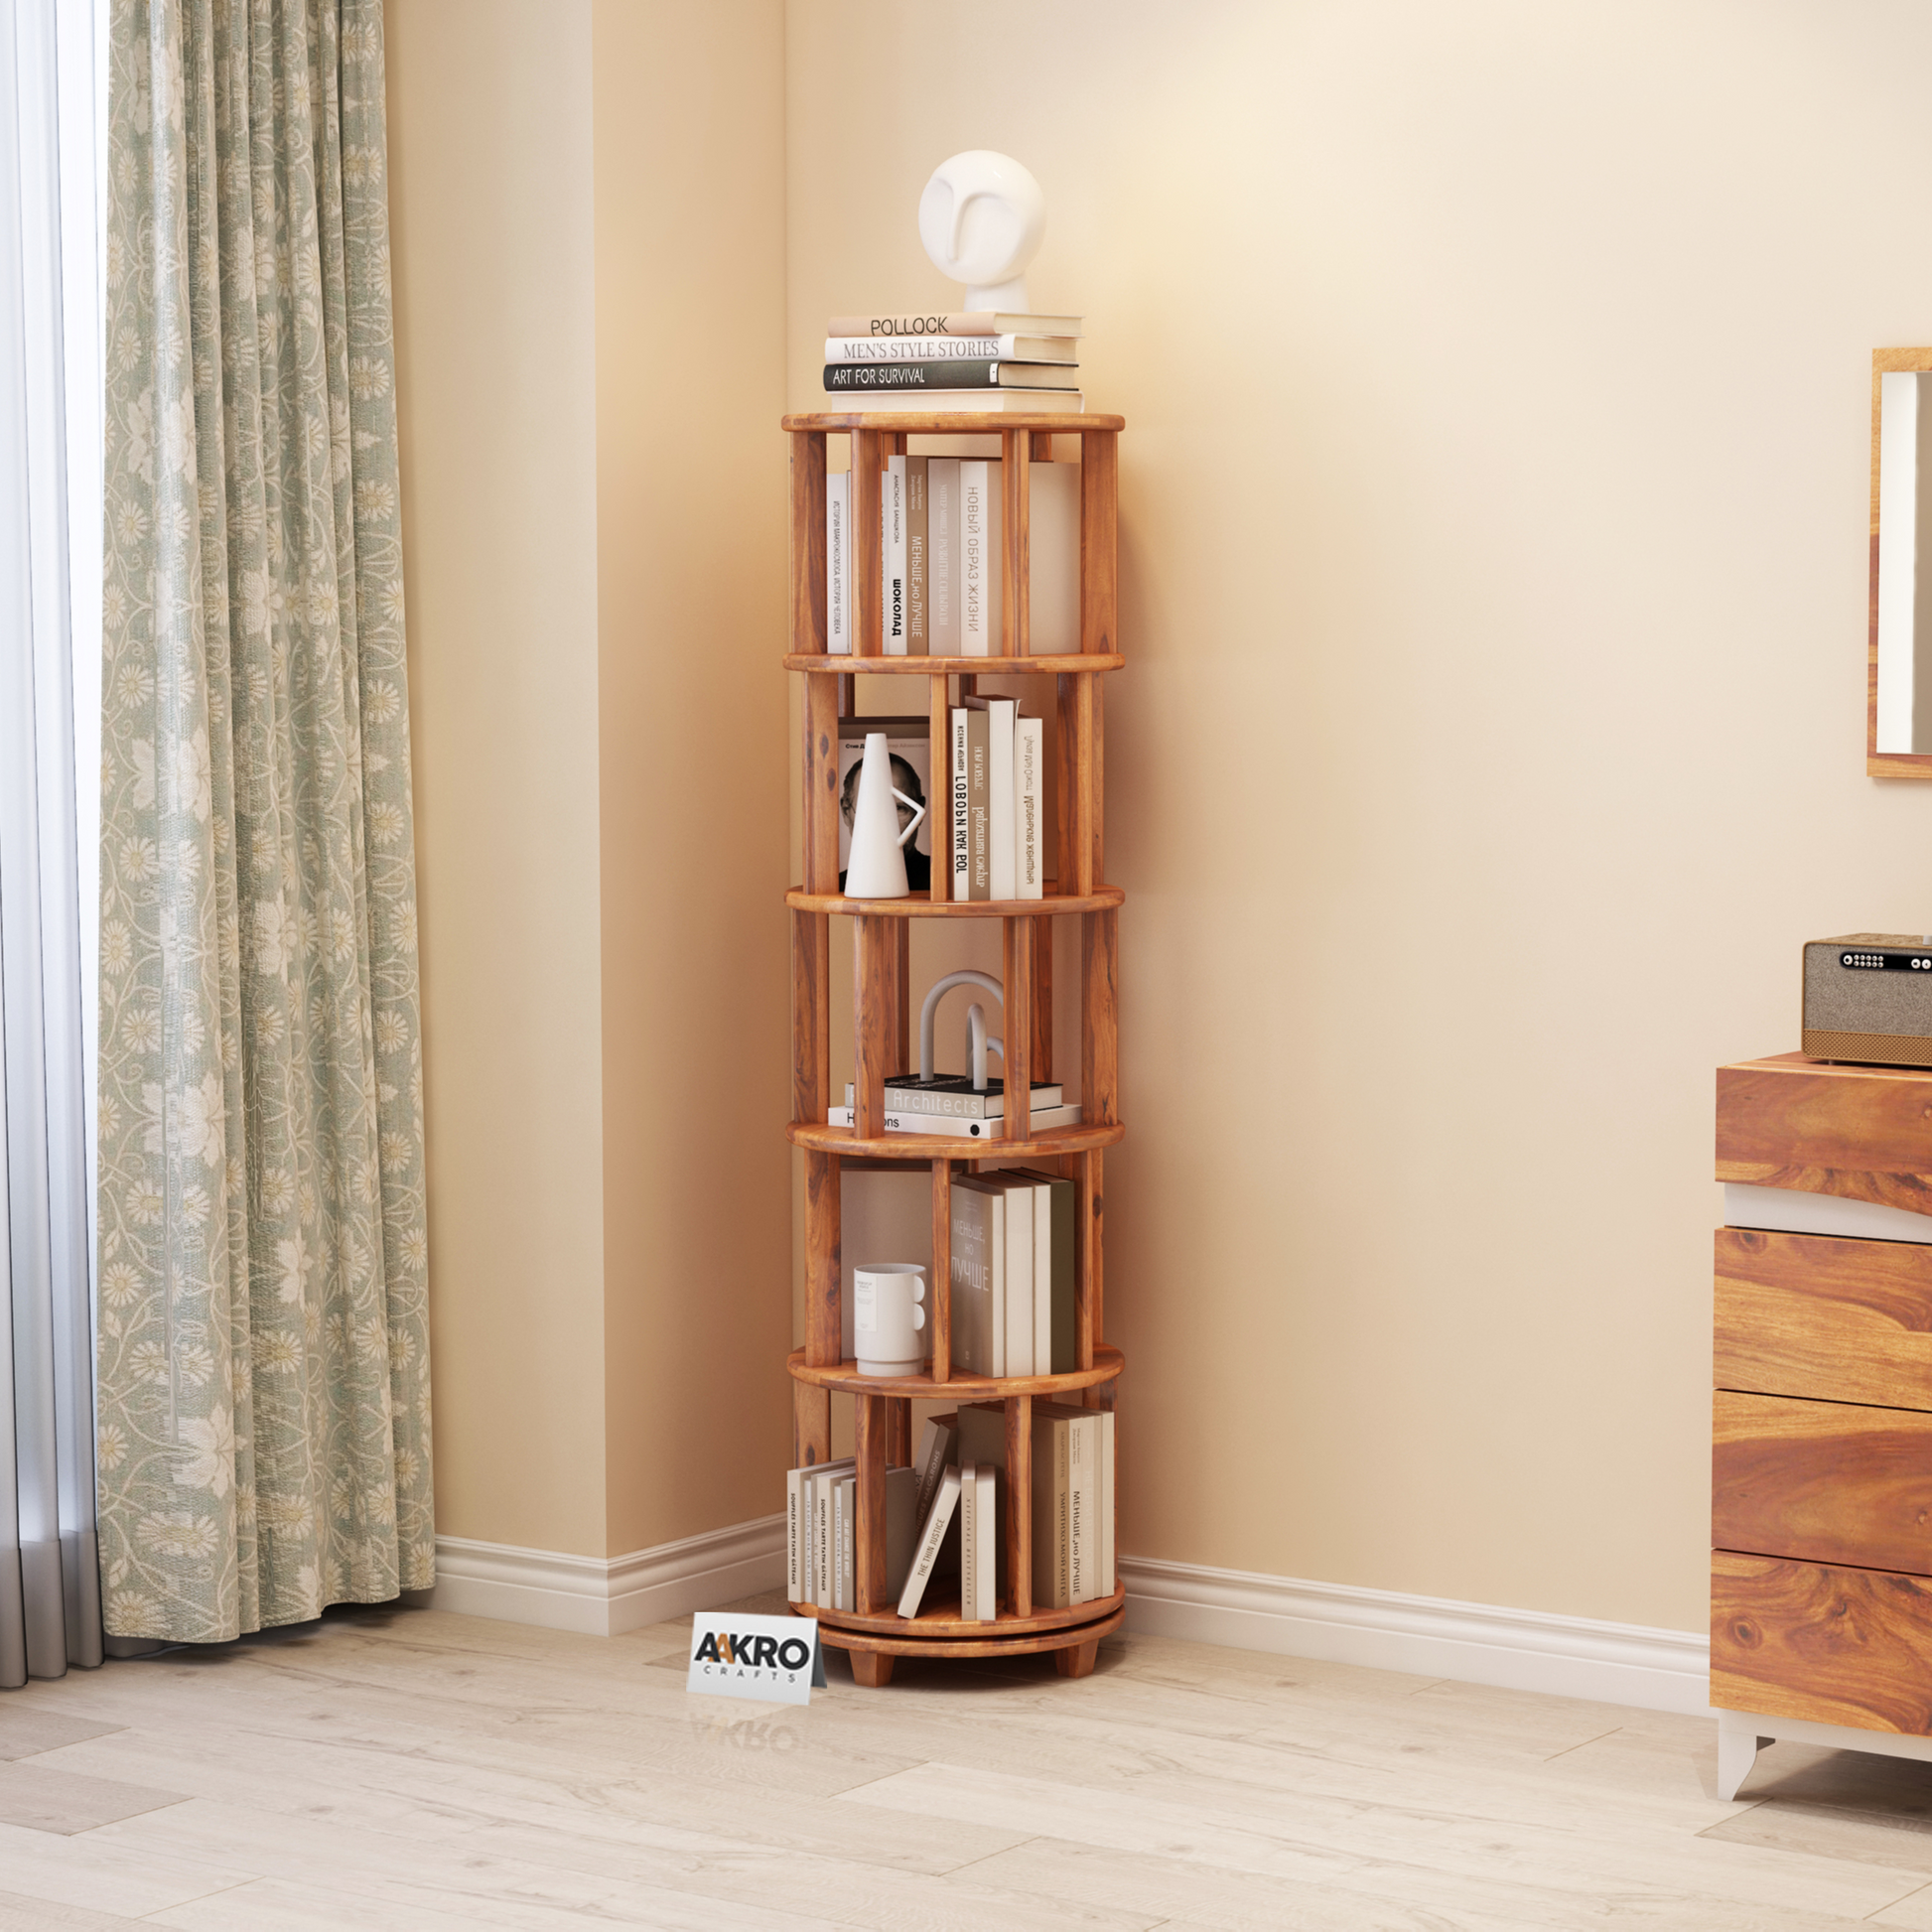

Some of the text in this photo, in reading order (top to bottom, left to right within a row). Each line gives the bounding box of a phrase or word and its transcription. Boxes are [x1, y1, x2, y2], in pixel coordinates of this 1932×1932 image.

[871, 317, 948, 336] POLLOCK
[891, 342, 934, 357] STYLE
[938, 341, 999, 355] STORIES
[833, 368, 924, 384] ART FOR SURVIVAL
[968, 486, 980, 631] НОВЫЙ ОБРАЗ ЖИЗНИ
[892, 579, 901, 635] ШОКОЛАД
[911, 601, 922, 637] ЛУЧШЕ
[894, 1090, 978, 1114] Architects
[951, 1257, 989, 1292] ЛУЧШЕ
[923, 1450, 940, 1500] MACARONS
[917, 1518, 945, 1577] THE THIN JUSTICE
[704, 1666, 796, 1683] CRAFTS
